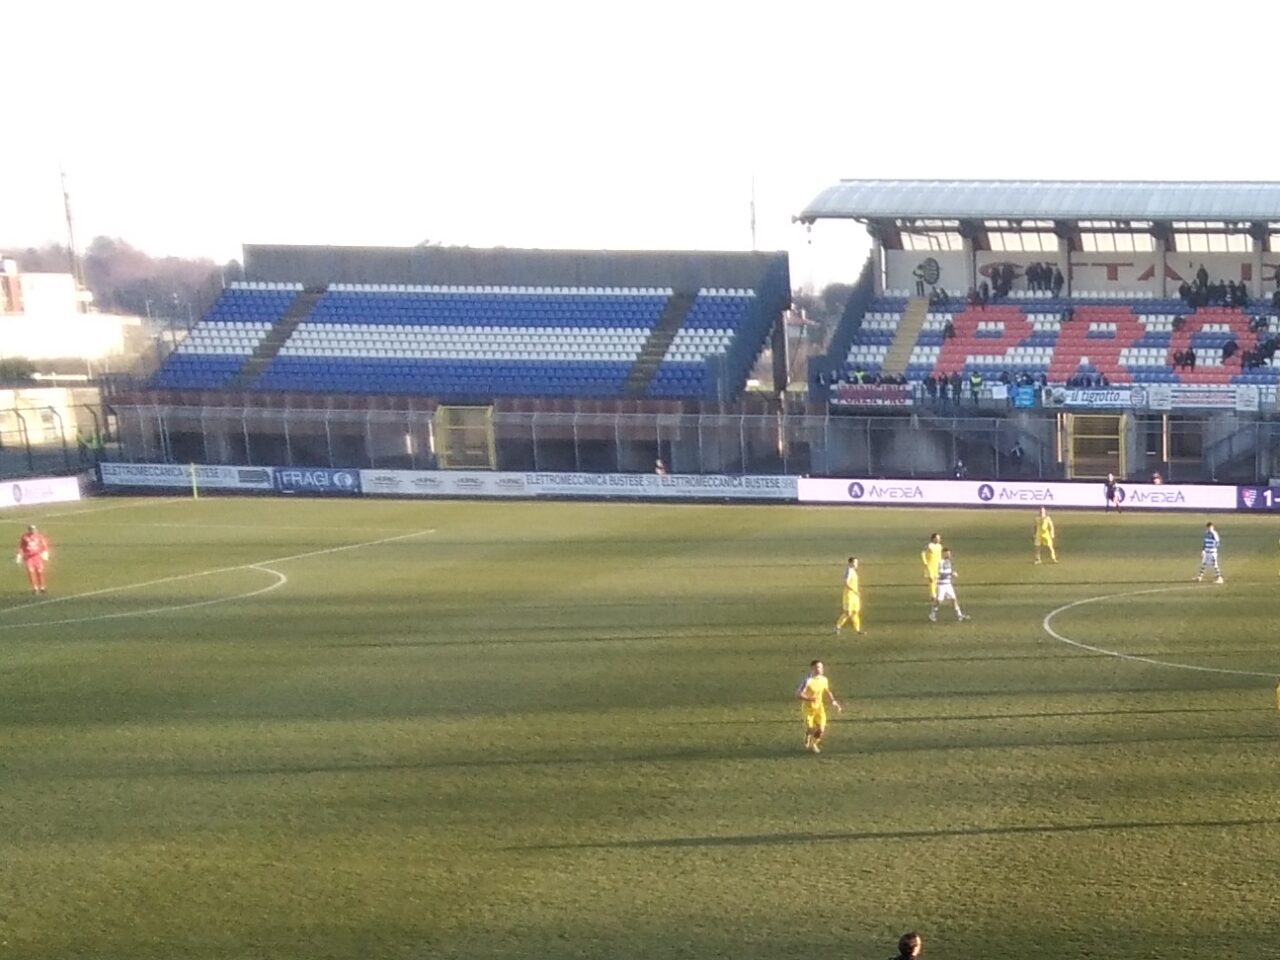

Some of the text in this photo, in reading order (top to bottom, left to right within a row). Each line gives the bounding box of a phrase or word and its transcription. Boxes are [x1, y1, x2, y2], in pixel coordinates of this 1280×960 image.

[281, 471, 329, 486] FRAGI
[526, 474, 608, 486] ELETTROMECCANICA
[609, 475, 645, 487] BUSTESE
[662, 475, 744, 488] ELETTROMECCANICA
[745, 477, 781, 489] BUSTESE
